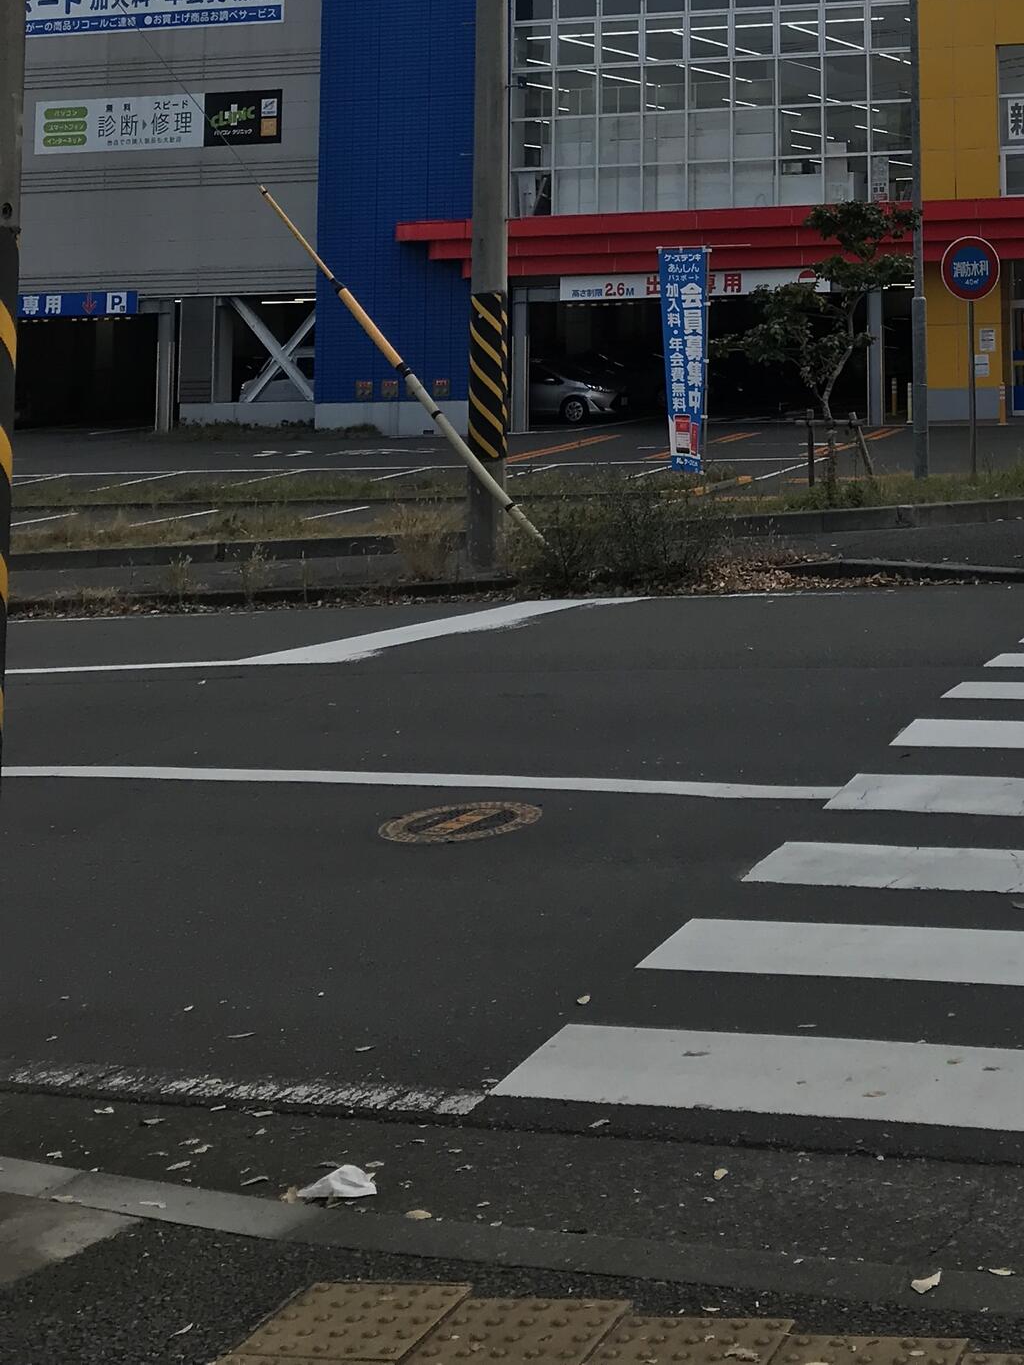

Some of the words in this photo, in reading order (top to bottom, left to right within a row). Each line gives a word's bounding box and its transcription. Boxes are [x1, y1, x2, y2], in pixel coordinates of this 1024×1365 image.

[153, 99, 189, 110] スピード
[97, 114, 139, 138] 診断
[150, 111, 193, 135] 修理
[667, 263, 700, 274] あんしん
[952, 259, 989, 278] 消防水利
[21, 294, 62, 315] 専用
[680, 282, 703, 414] 会員募集中
